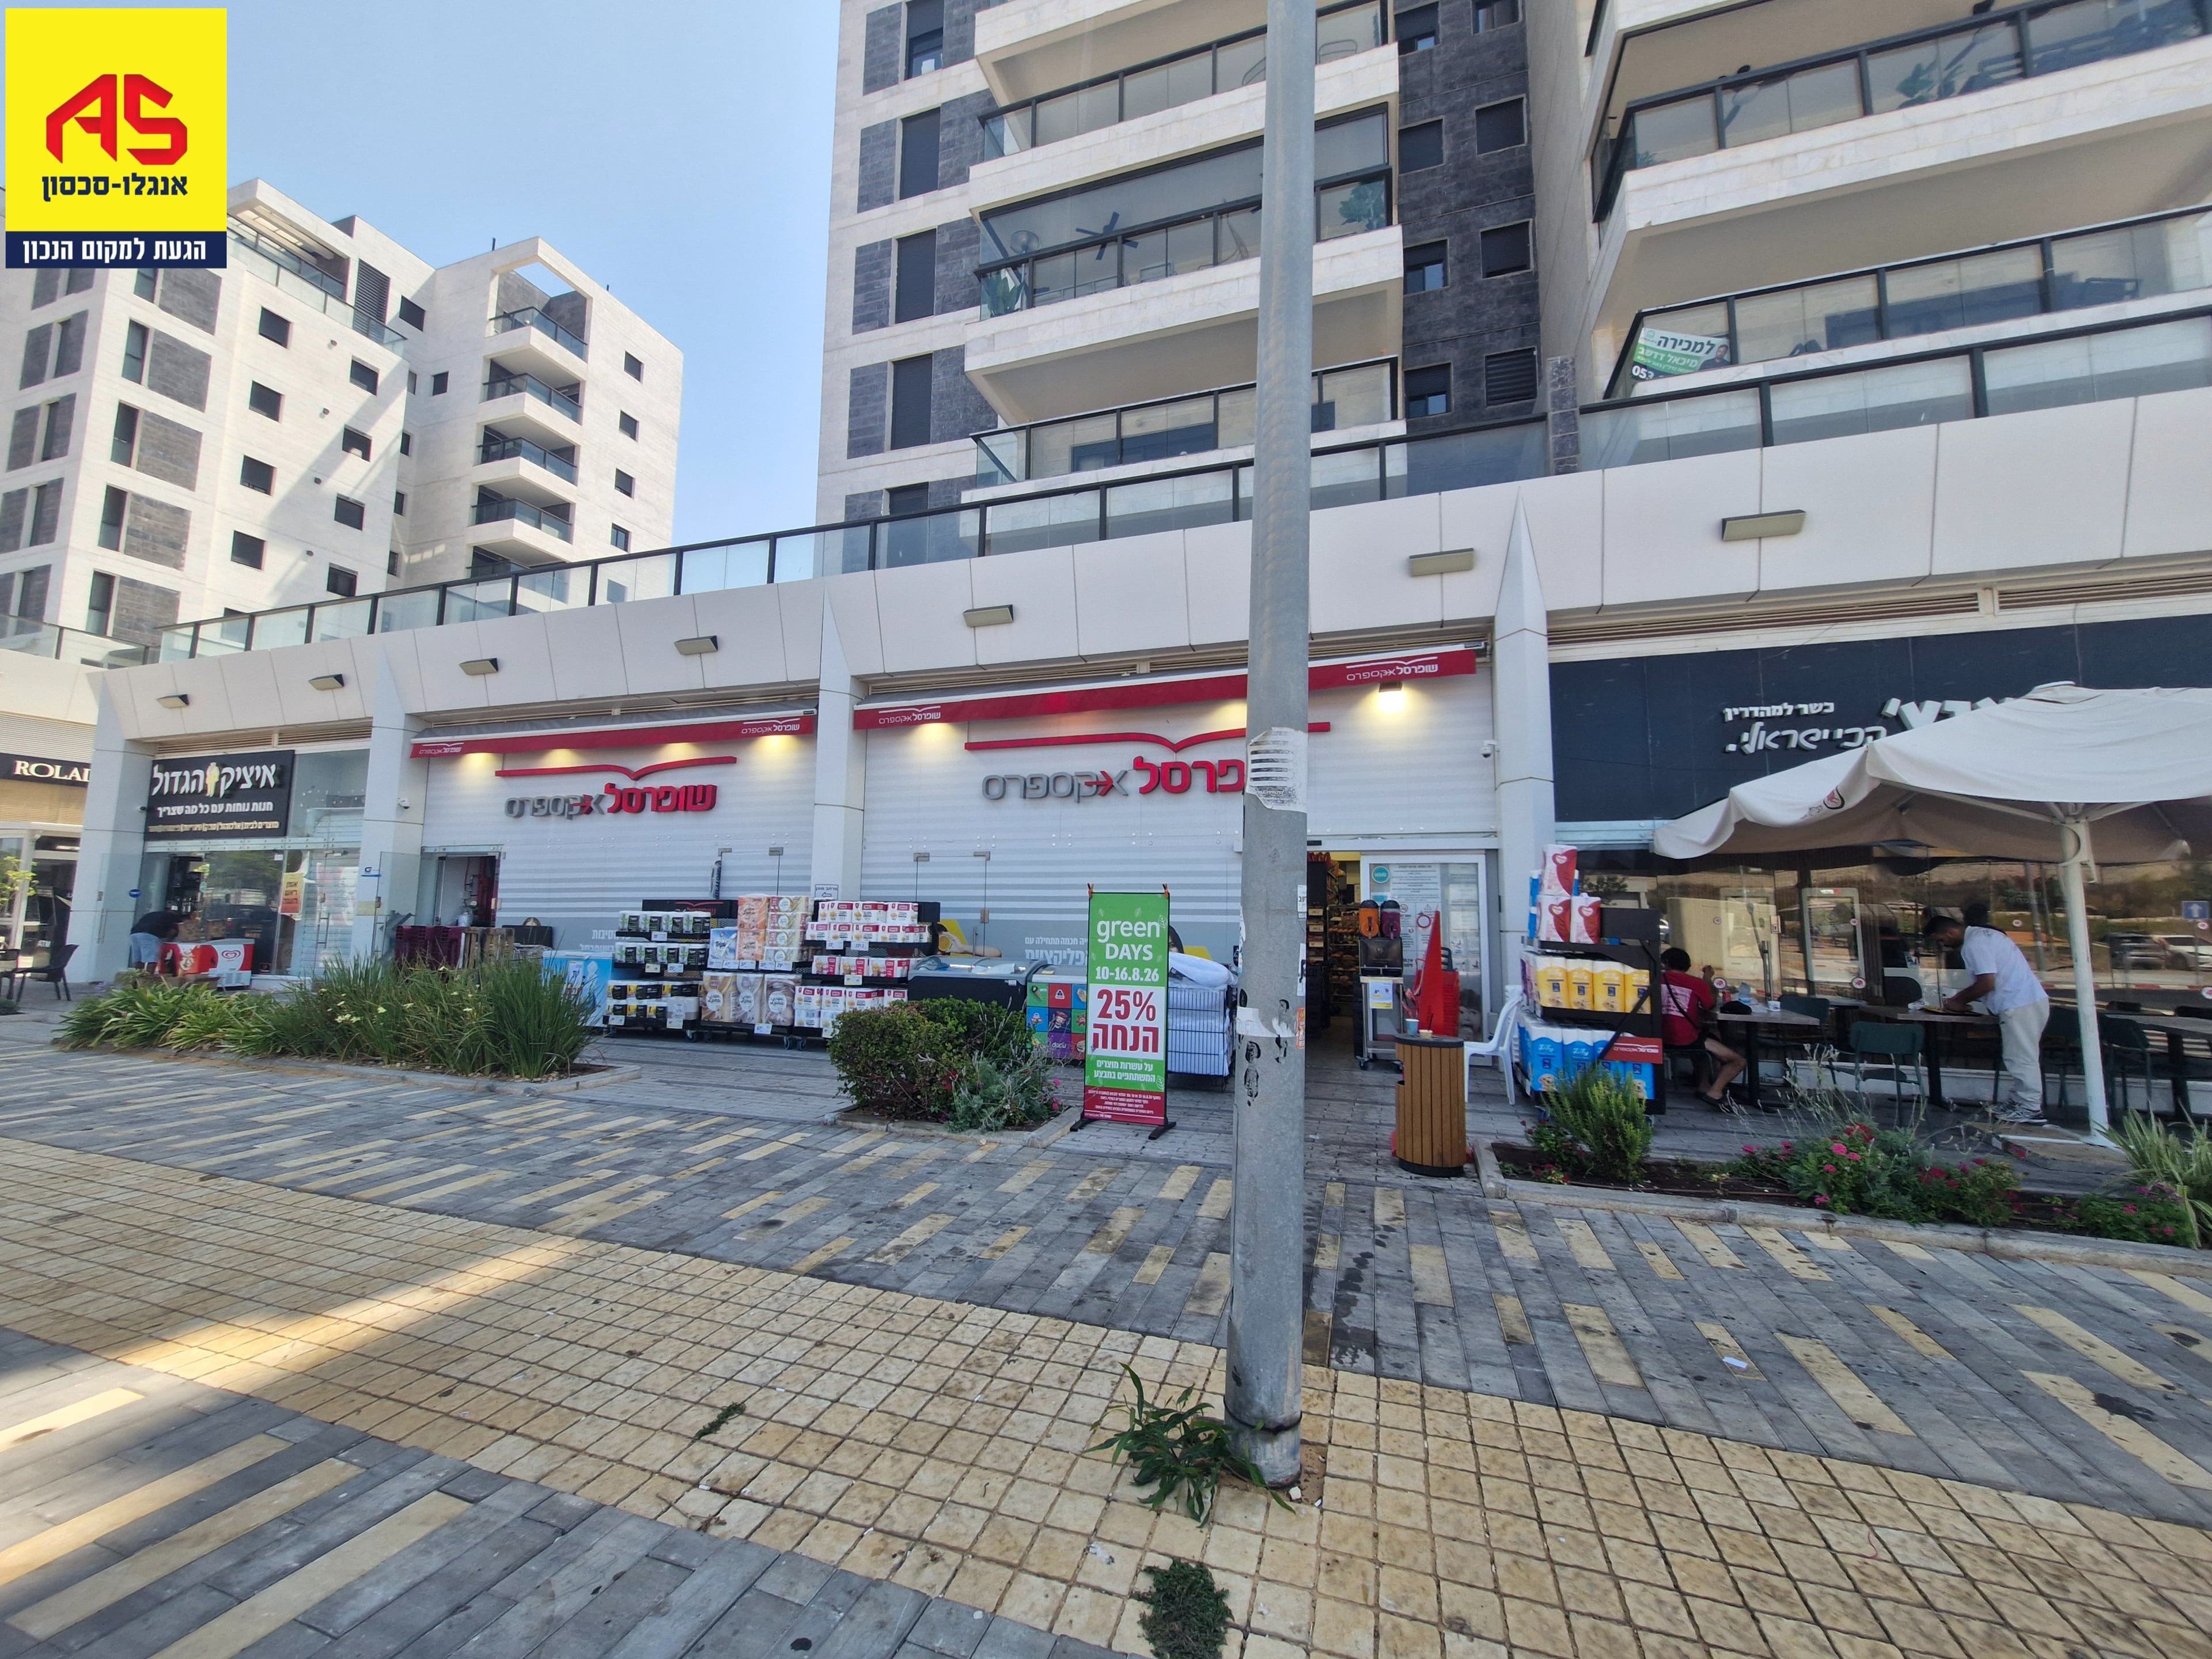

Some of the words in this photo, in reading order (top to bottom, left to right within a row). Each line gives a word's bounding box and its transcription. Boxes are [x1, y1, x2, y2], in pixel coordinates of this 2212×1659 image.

[1657, 335, 1716, 355] למכירה
[1346, 669, 1396, 681] אקספרס
[1396, 664, 1438, 675] שופרסל
[1723, 702, 1794, 722] למהדרין
[1796, 702, 1835, 715] כשר
[878, 715, 912, 724] אקספרס
[912, 712, 941, 721] שופרסל
[151, 764, 204, 796] הגדול
[219, 764, 276, 798] איציק
[1133, 756, 1245, 794] פרסל
[982, 770, 1128, 802] אקספרס
[604, 782, 718, 813] שופרסל
[157, 805, 184, 818] שצריך
[185, 805, 198, 815] מה
[199, 803, 209, 813] כל
[211, 803, 225, 813] עם
[225, 802, 250, 813] נוחות
[251, 801, 274, 812] חנות
[504, 793, 605, 820] אקספרס
[1097, 920, 1160, 943] green
[1025, 937, 1035, 945] עם
[1060, 937, 1078, 945] חכמה
[1105, 944, 1153, 961] DAYS
[1096, 966, 1160, 982] 10-16.8.26
[1097, 989, 1156, 1021] 25%
[1093, 1023, 1160, 1053] הנחה
[1096, 1060, 1119, 1070] מוצרים
[1120, 1061, 1142, 1071] עשרות
[1144, 1062, 1153, 1071] על
[1094, 1070, 1116, 1079] במבצע
[1117, 1072, 1156, 1082] המשתתפים
